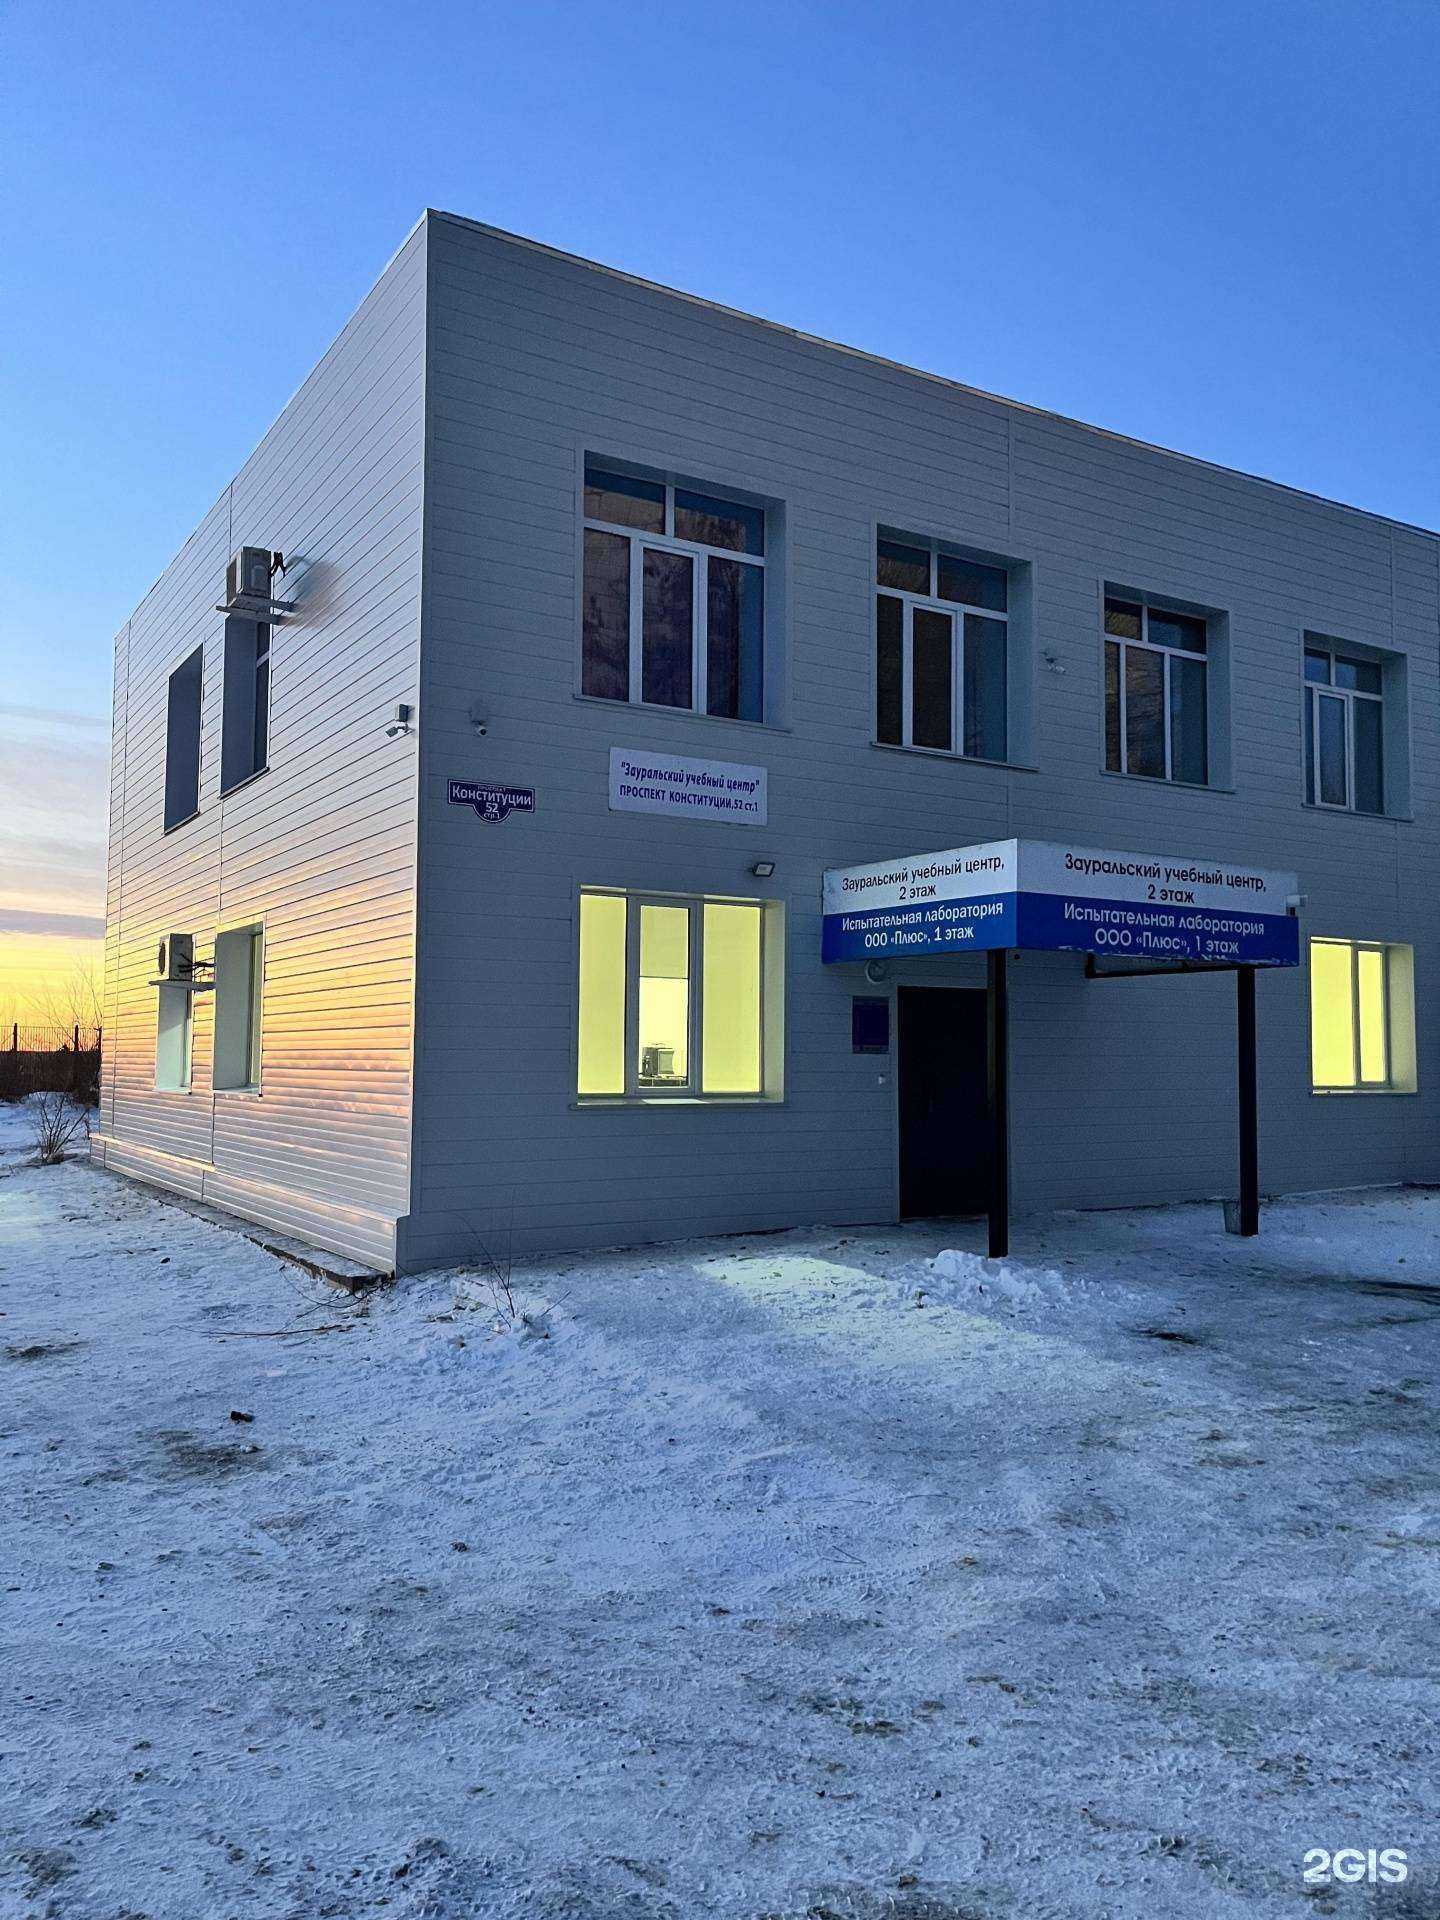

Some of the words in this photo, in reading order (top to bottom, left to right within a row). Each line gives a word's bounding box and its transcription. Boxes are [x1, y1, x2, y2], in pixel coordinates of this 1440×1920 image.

[621, 761, 684, 783] "Зауральский
[686, 771, 724, 788] учебный
[726, 778, 760, 795] центр"
[452, 785, 532, 806] Конституции
[619, 784, 666, 801] ПРОСПЕКТ
[485, 802, 499, 813] 52
[842, 869, 909, 892] Зауральский
[911, 859, 962, 884] учебный
[965, 856, 1005, 873] центр,
[1065, 853, 1160, 879] Зауральский
[1164, 867, 1223, 886] учебный
[1226, 874, 1267, 892] центр,
[899, 886, 906, 900] 2
[909, 884, 937, 898] этаж
[1147, 884, 1155, 900] 2
[1160, 888, 1195, 904] этаж
[842, 909, 922, 931] Испытательная
[924, 902, 1003, 922] лаборатория
[1064, 902, 1175, 928] Испытательная
[1178, 914, 1265, 935] лаборатория
[865, 932, 888, 948] ООО
[890, 930, 931, 946] «Плюс»,
[934, 926, 942, 941] 1
[945, 925, 974, 940] этаж
[1095, 928, 1132, 946] ООО
[1136, 933, 1190, 953] «Плюс»,
[1195, 935, 1200, 951] 1
[1206, 939, 1240, 954] этаж
